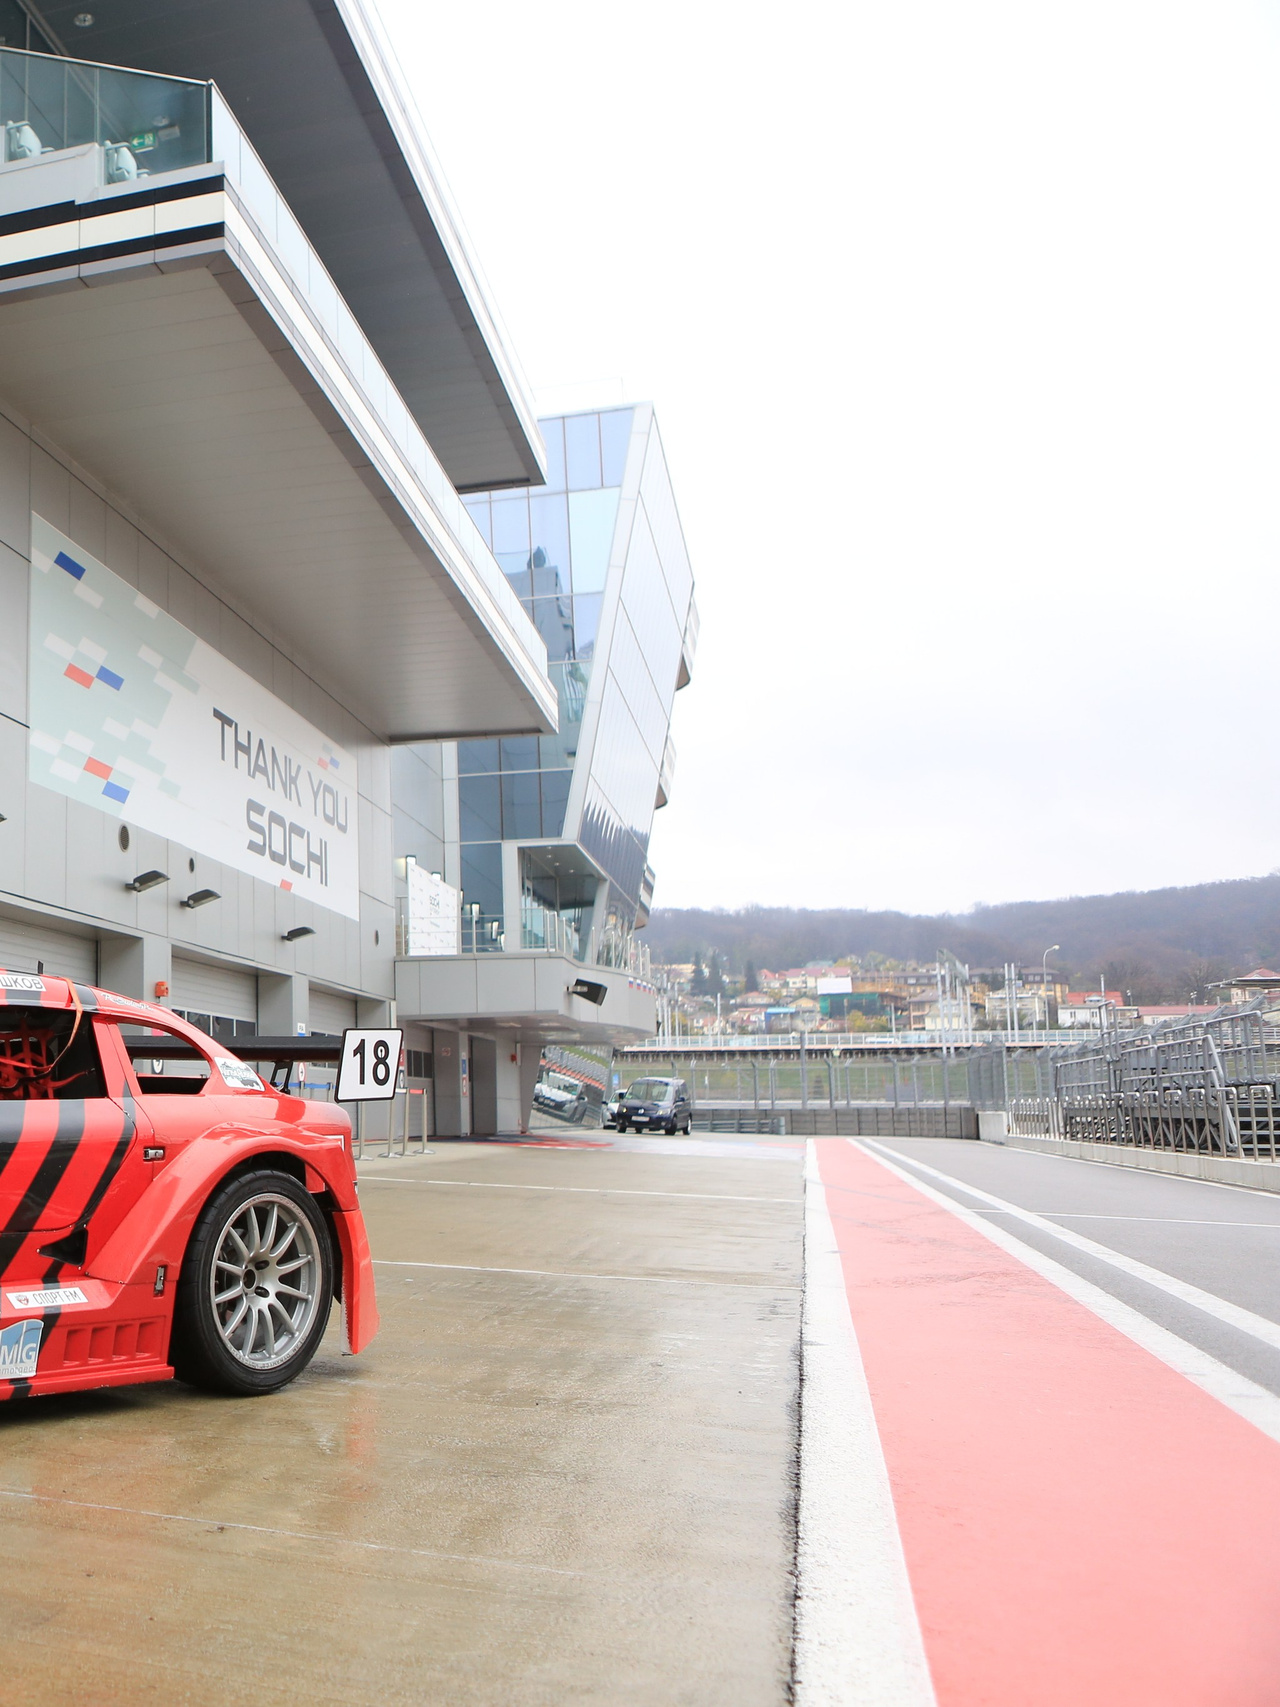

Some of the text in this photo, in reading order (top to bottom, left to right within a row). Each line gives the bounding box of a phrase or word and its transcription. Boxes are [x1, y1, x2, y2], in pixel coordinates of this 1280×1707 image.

[213, 706, 348, 834] THANK YOU
[246, 797, 328, 887] SOCHI
[353, 1038, 390, 1086] 18
[32, 1290, 82, 1305] СПОРТ FM
